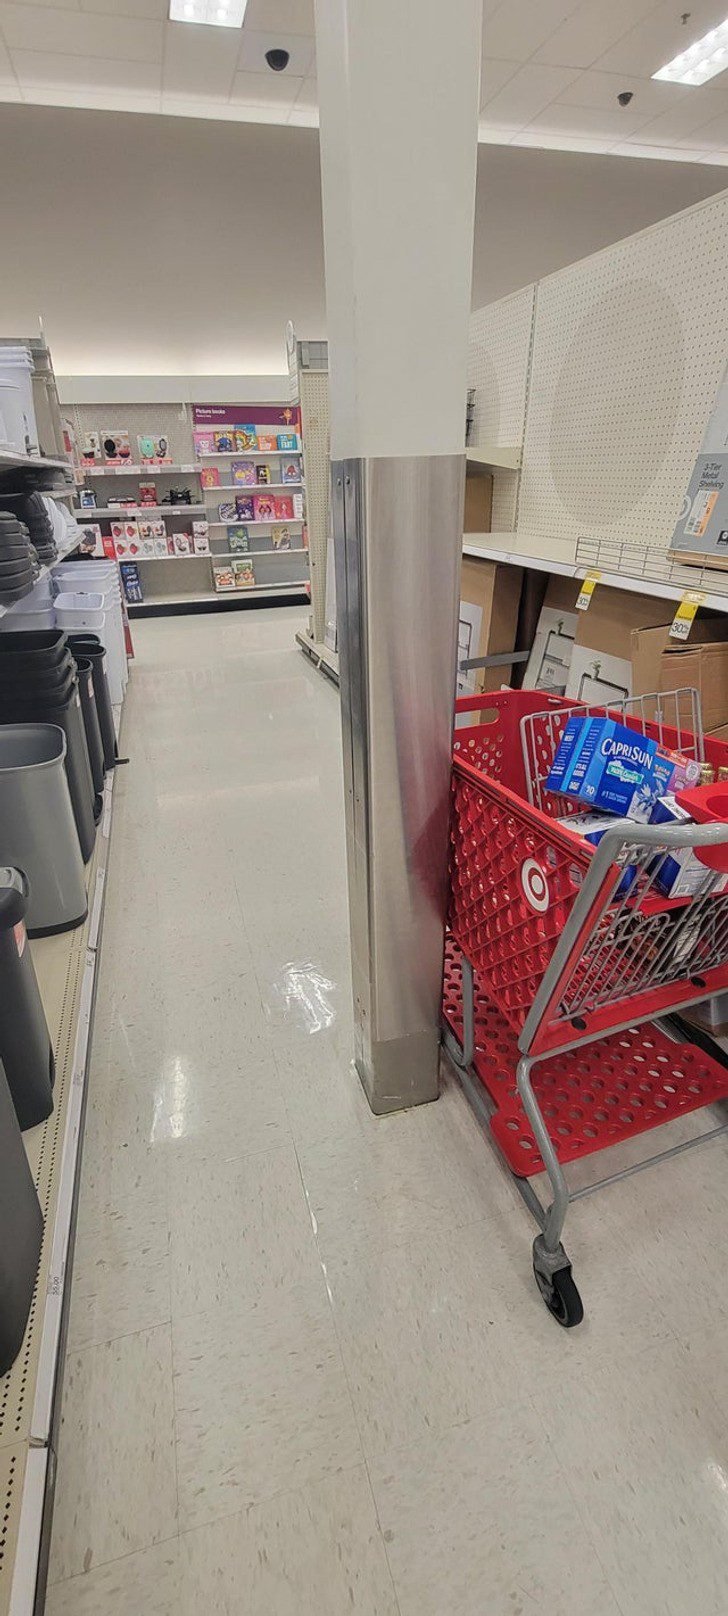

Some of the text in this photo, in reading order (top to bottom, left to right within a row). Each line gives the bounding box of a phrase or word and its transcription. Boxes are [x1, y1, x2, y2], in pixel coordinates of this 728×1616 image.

[703, 462, 722, 472] 3-Tier
[700, 471, 719, 480] Metal
[698, 479, 725, 490] Shelving
